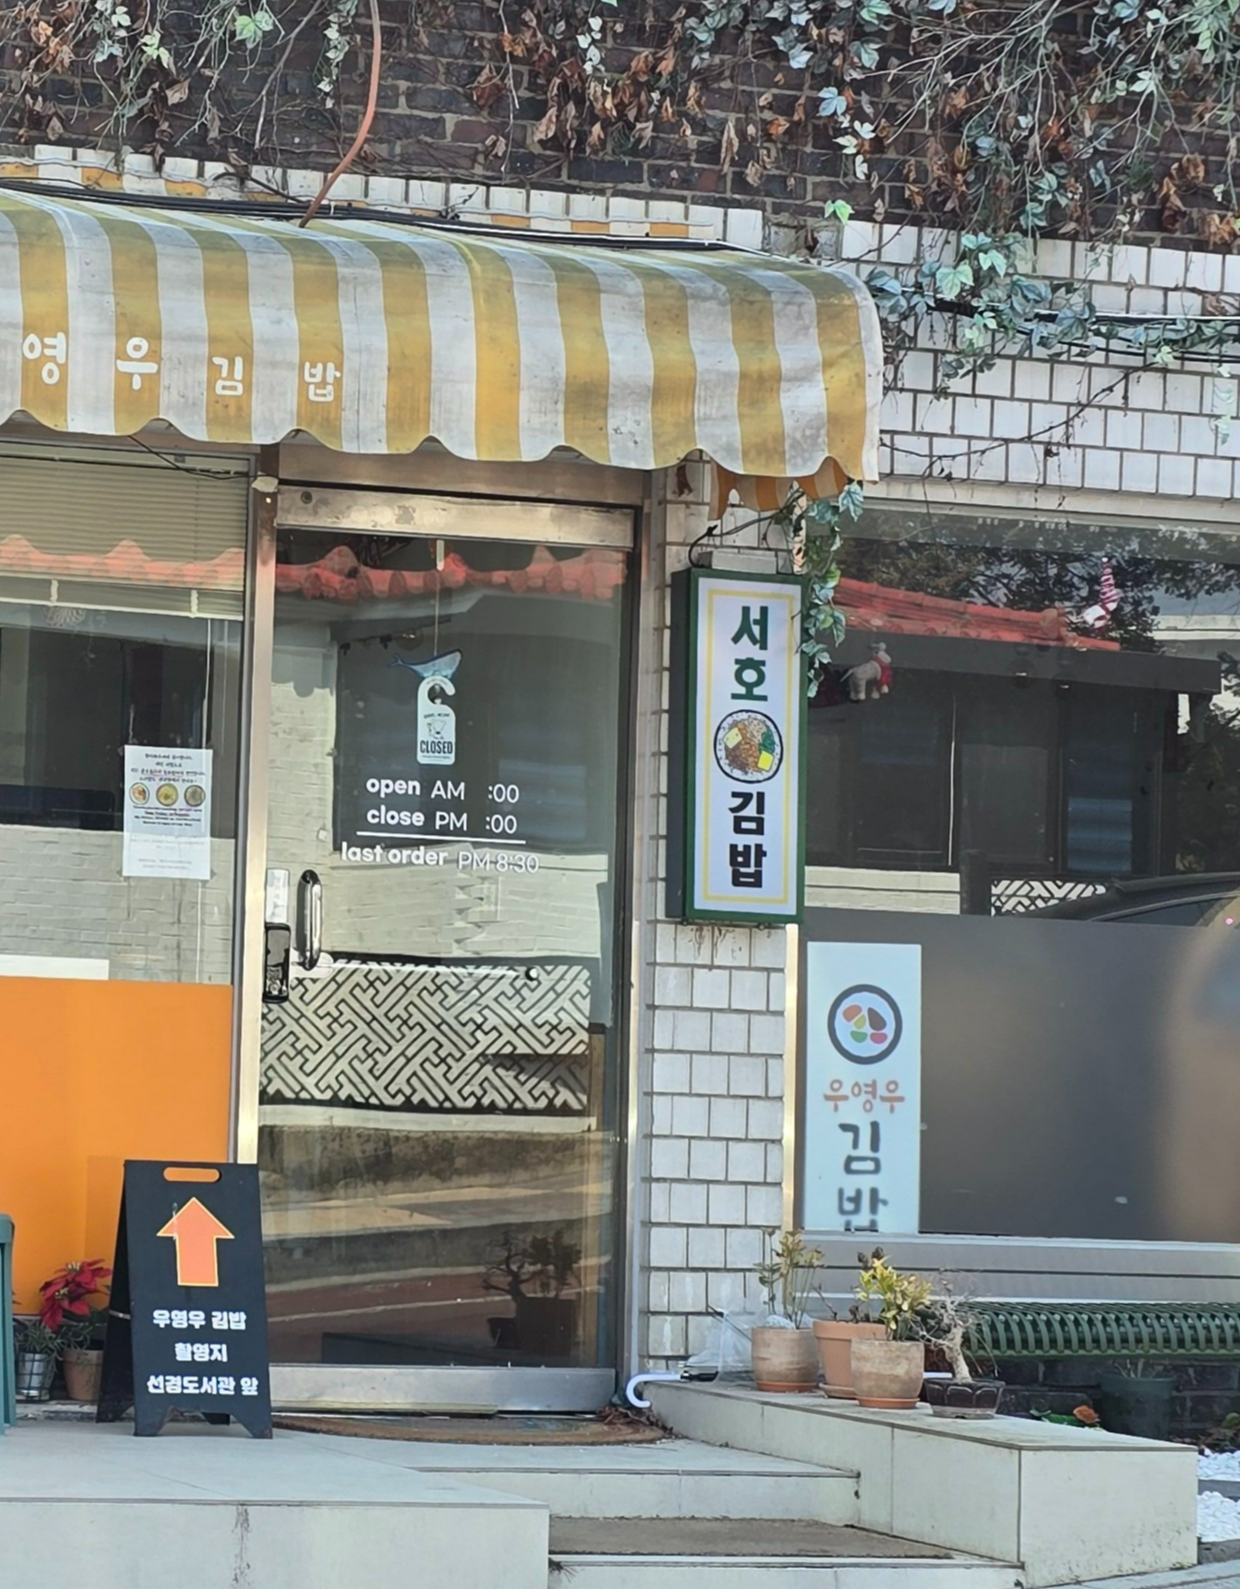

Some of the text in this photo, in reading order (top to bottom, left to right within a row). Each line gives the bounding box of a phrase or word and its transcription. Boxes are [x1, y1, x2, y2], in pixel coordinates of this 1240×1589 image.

[211, 355, 342, 403] 김밥
[419, 739, 454, 754] CLOSED
[727, 605, 770, 889] 서호 김밥
[365, 777, 520, 804] open AM :00
[366, 804, 518, 834] close PM :00
[341, 841, 540, 874] last order PM 8:30
[823, 1078, 906, 1114] 우영우
[152, 1309, 247, 1331] 우영우 김밥
[174, 1342, 228, 1363] 촬영지
[146, 1375, 259, 1396] 선경도서관 앞
